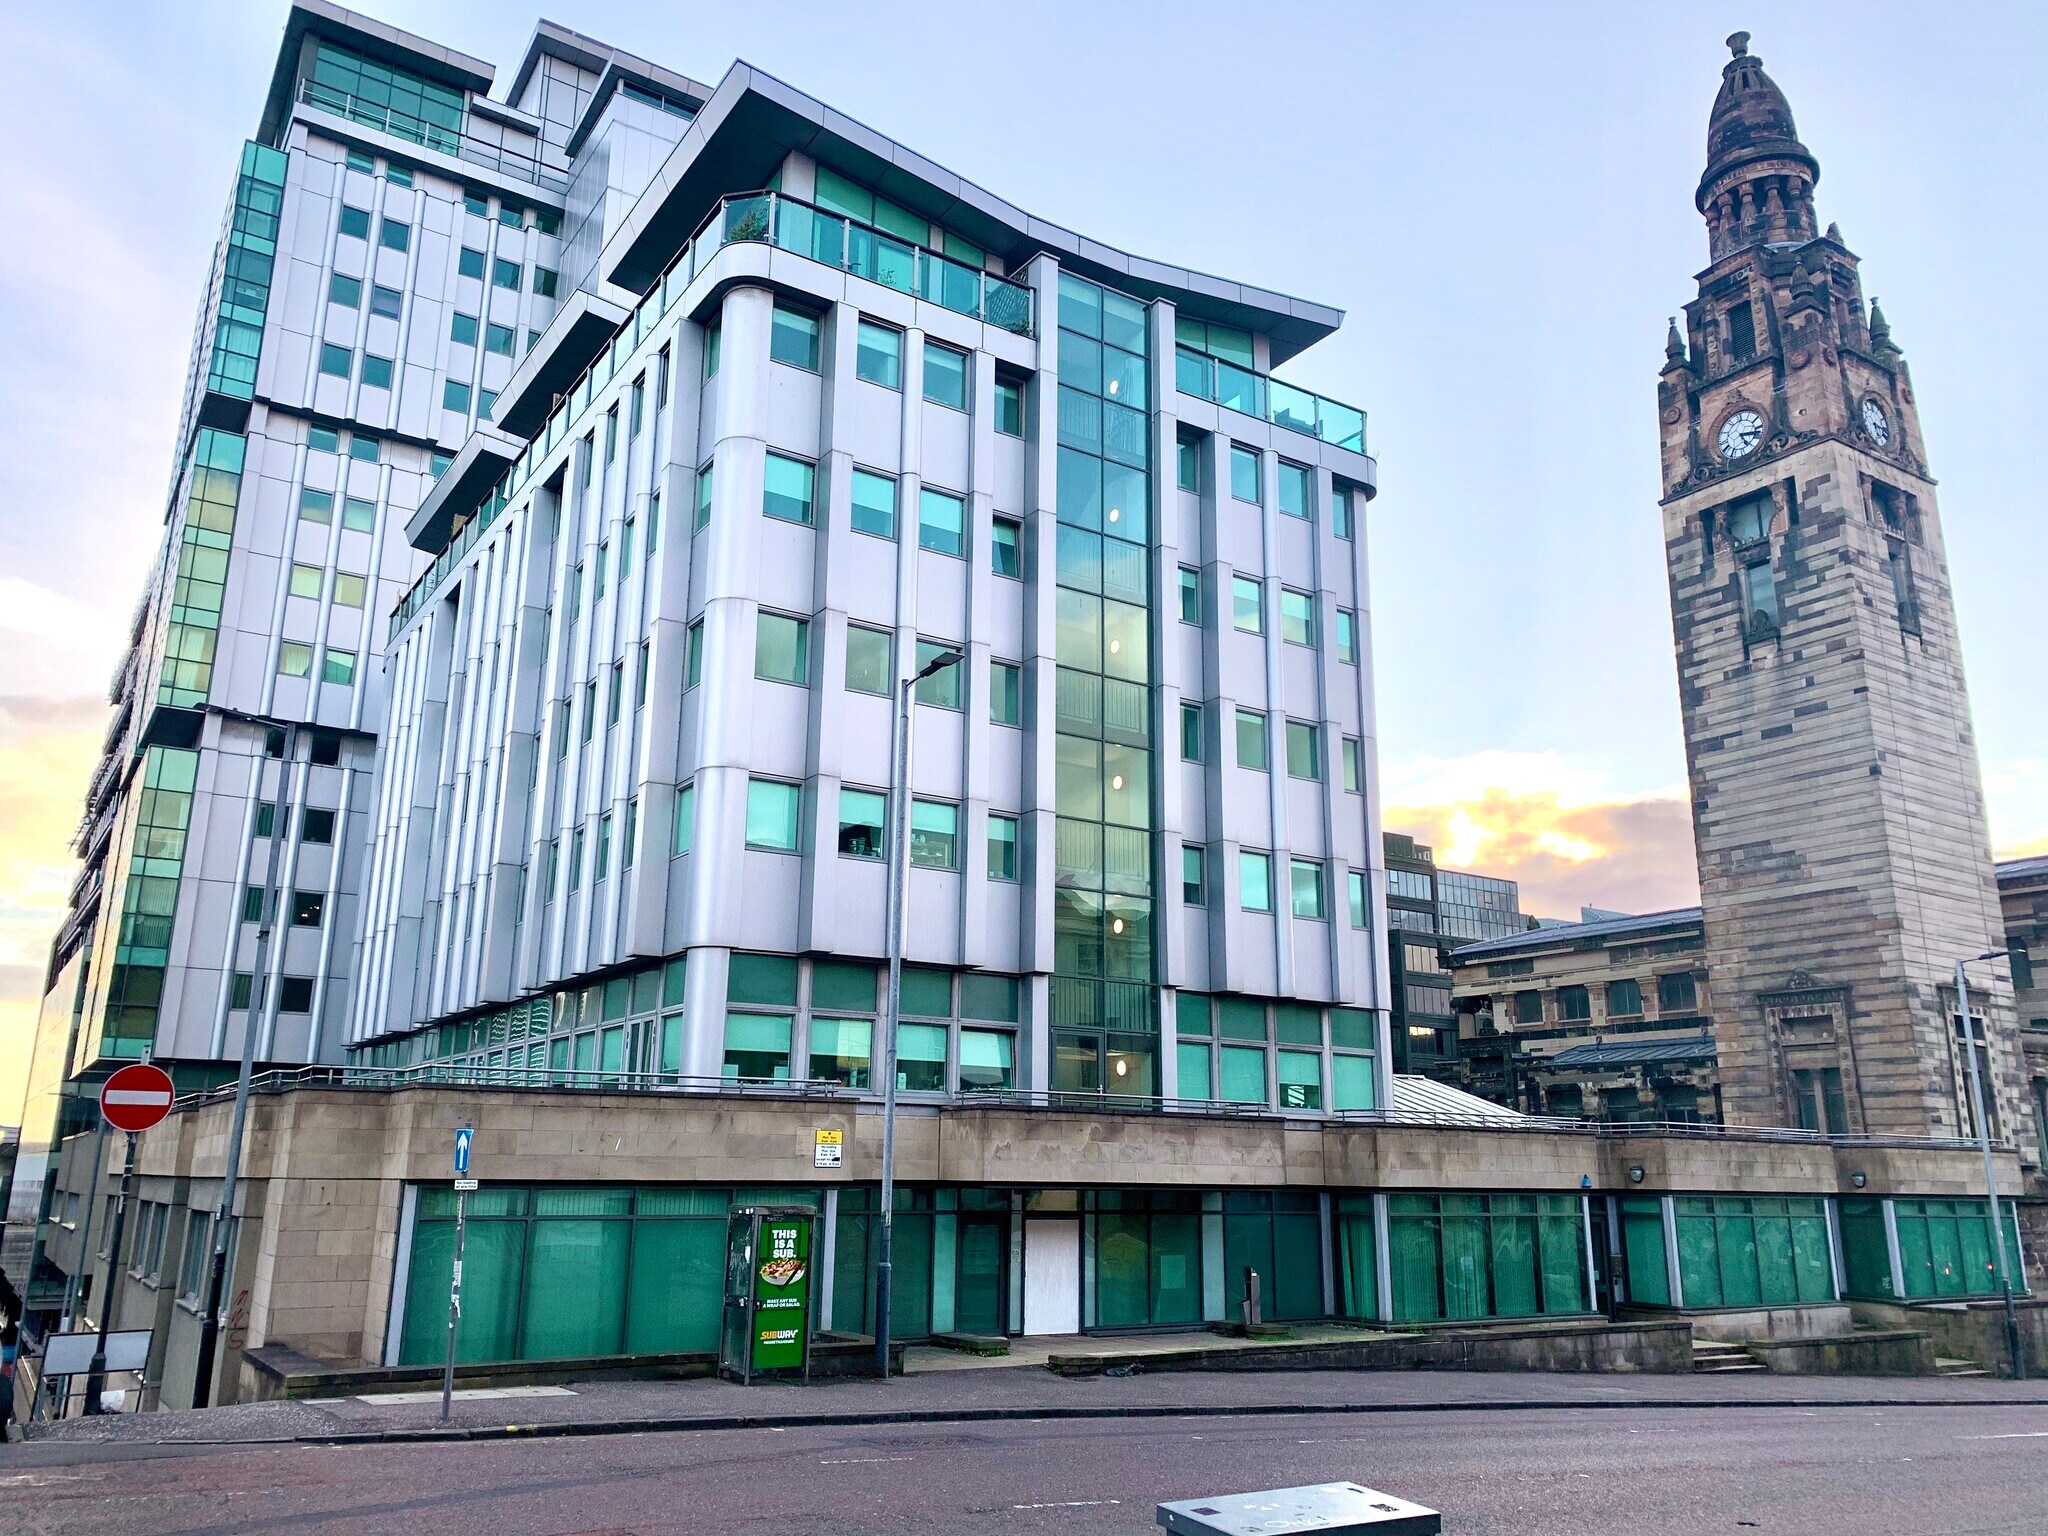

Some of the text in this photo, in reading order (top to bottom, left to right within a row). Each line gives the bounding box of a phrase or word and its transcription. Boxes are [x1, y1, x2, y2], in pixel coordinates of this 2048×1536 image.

[772, 1230, 797, 1239] THIS
[774, 1239, 794, 1248] IS A
[772, 1249, 796, 1258] SUB.
[760, 1329, 798, 1340] SUBWAY
